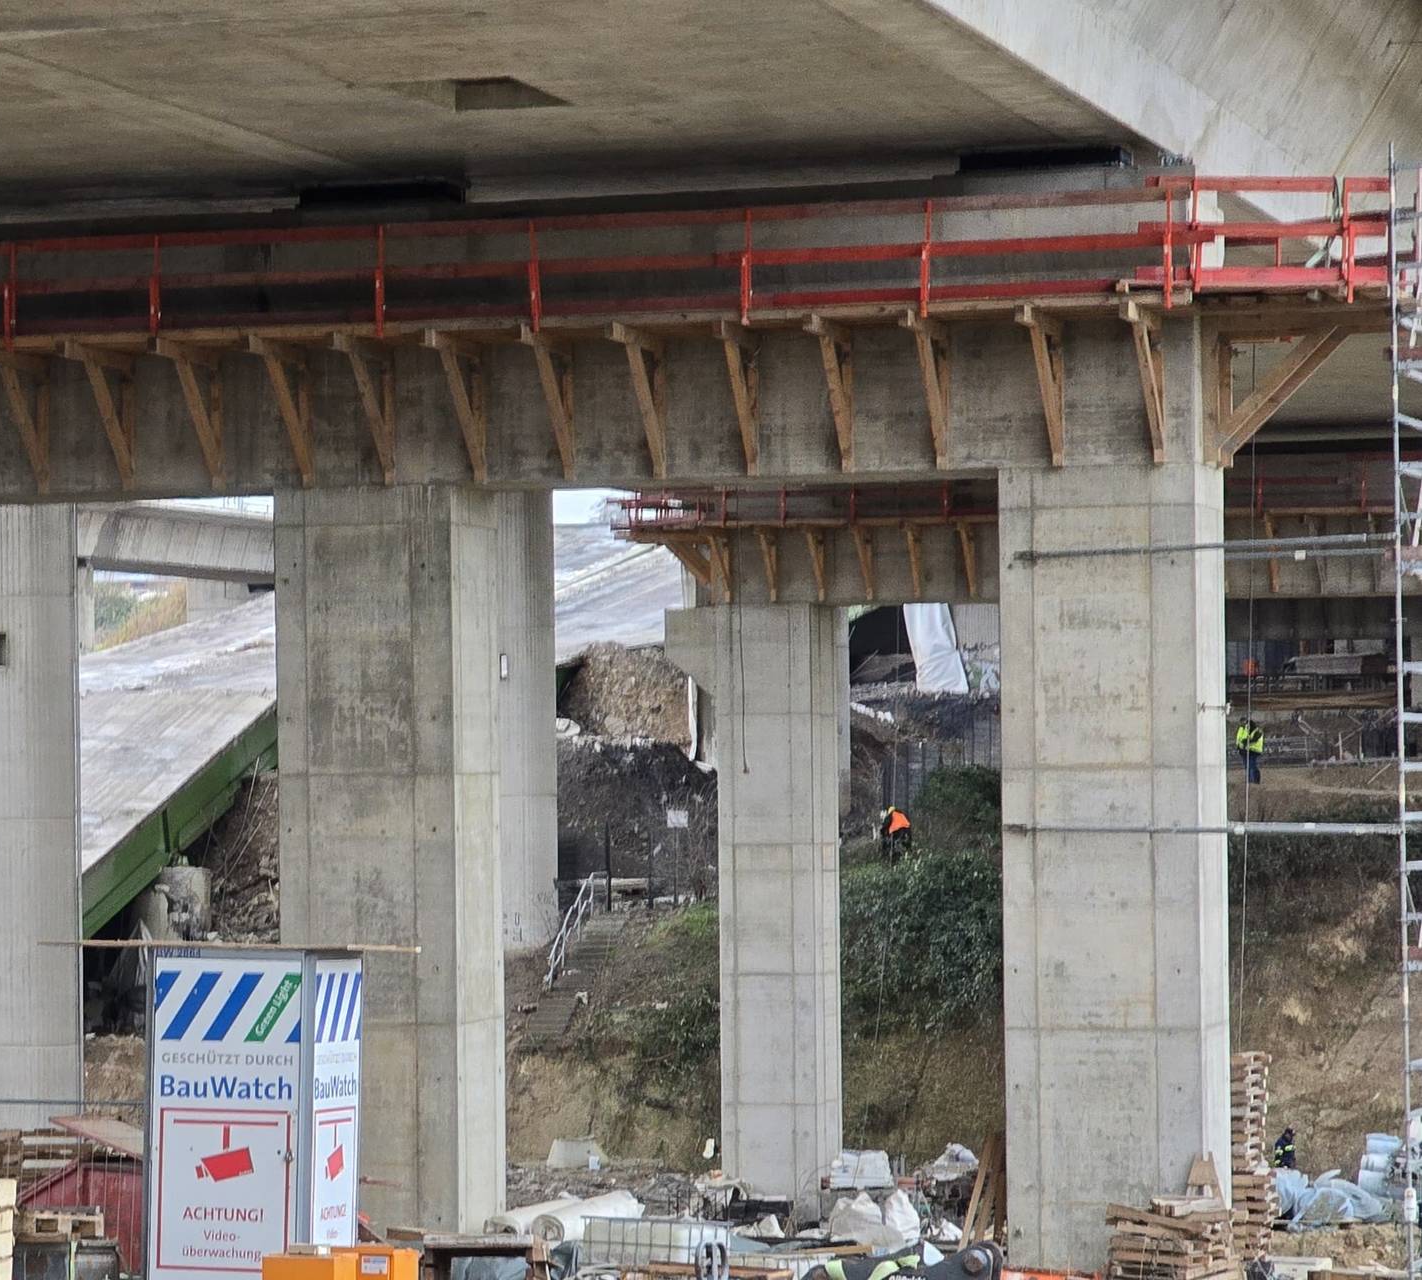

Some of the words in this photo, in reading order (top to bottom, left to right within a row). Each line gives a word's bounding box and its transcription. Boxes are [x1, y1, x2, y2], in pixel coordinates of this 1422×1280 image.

[255, 1006, 278, 1037] Green
[272, 980, 294, 1007] Light
[161, 1050, 241, 1066] GESCHÜTZT
[245, 1053, 294, 1067] DURCH
[160, 1074, 293, 1100] BauWatch
[314, 1072, 357, 1100] BauWatch
[182, 1206, 264, 1222] ACHTUNG!
[202, 1229, 241, 1242] Video-
[181, 1244, 262, 1262] überwachung
